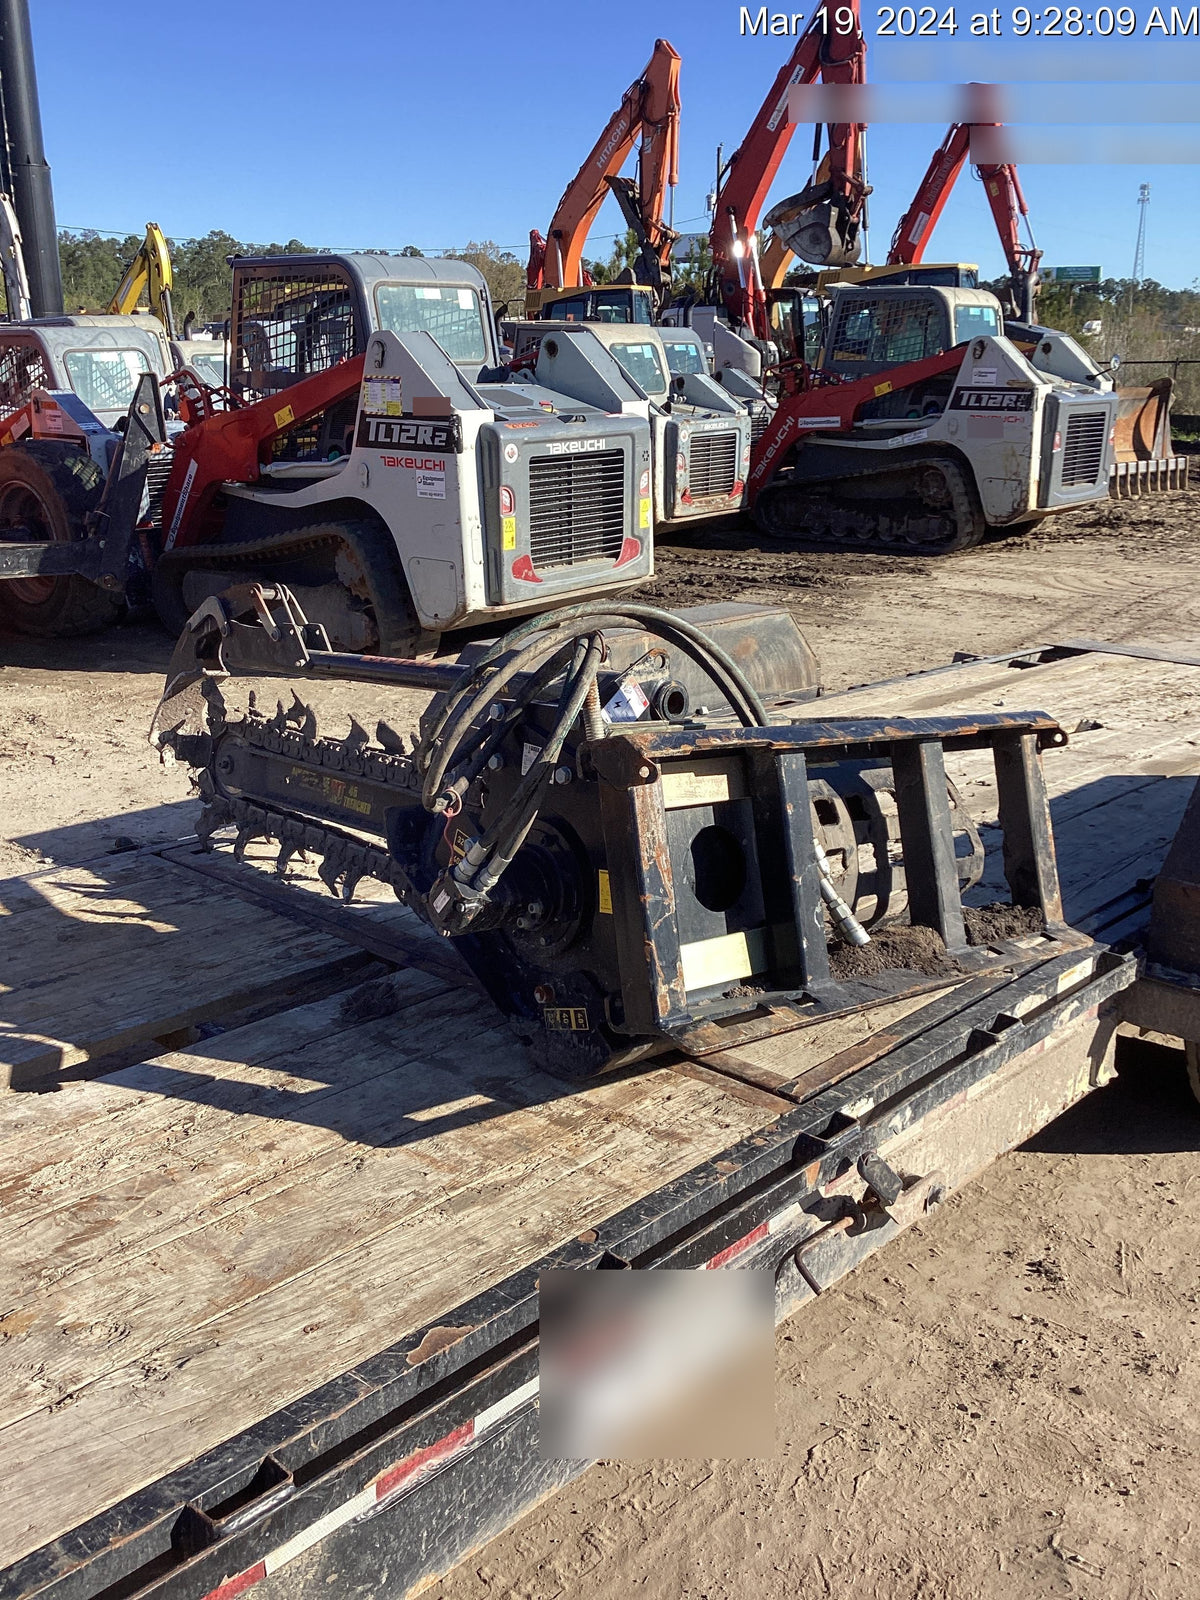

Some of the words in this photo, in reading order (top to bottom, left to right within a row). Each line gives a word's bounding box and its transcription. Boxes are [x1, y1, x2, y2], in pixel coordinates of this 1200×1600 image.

[596, 119, 627, 168] HITACHI
[365, 417, 451, 446] TL12R2
[546, 438, 606, 454] TAKEUCHI
[750, 415, 795, 480] TAKEUCHI
[380, 456, 446, 471] TAKEUCHI
